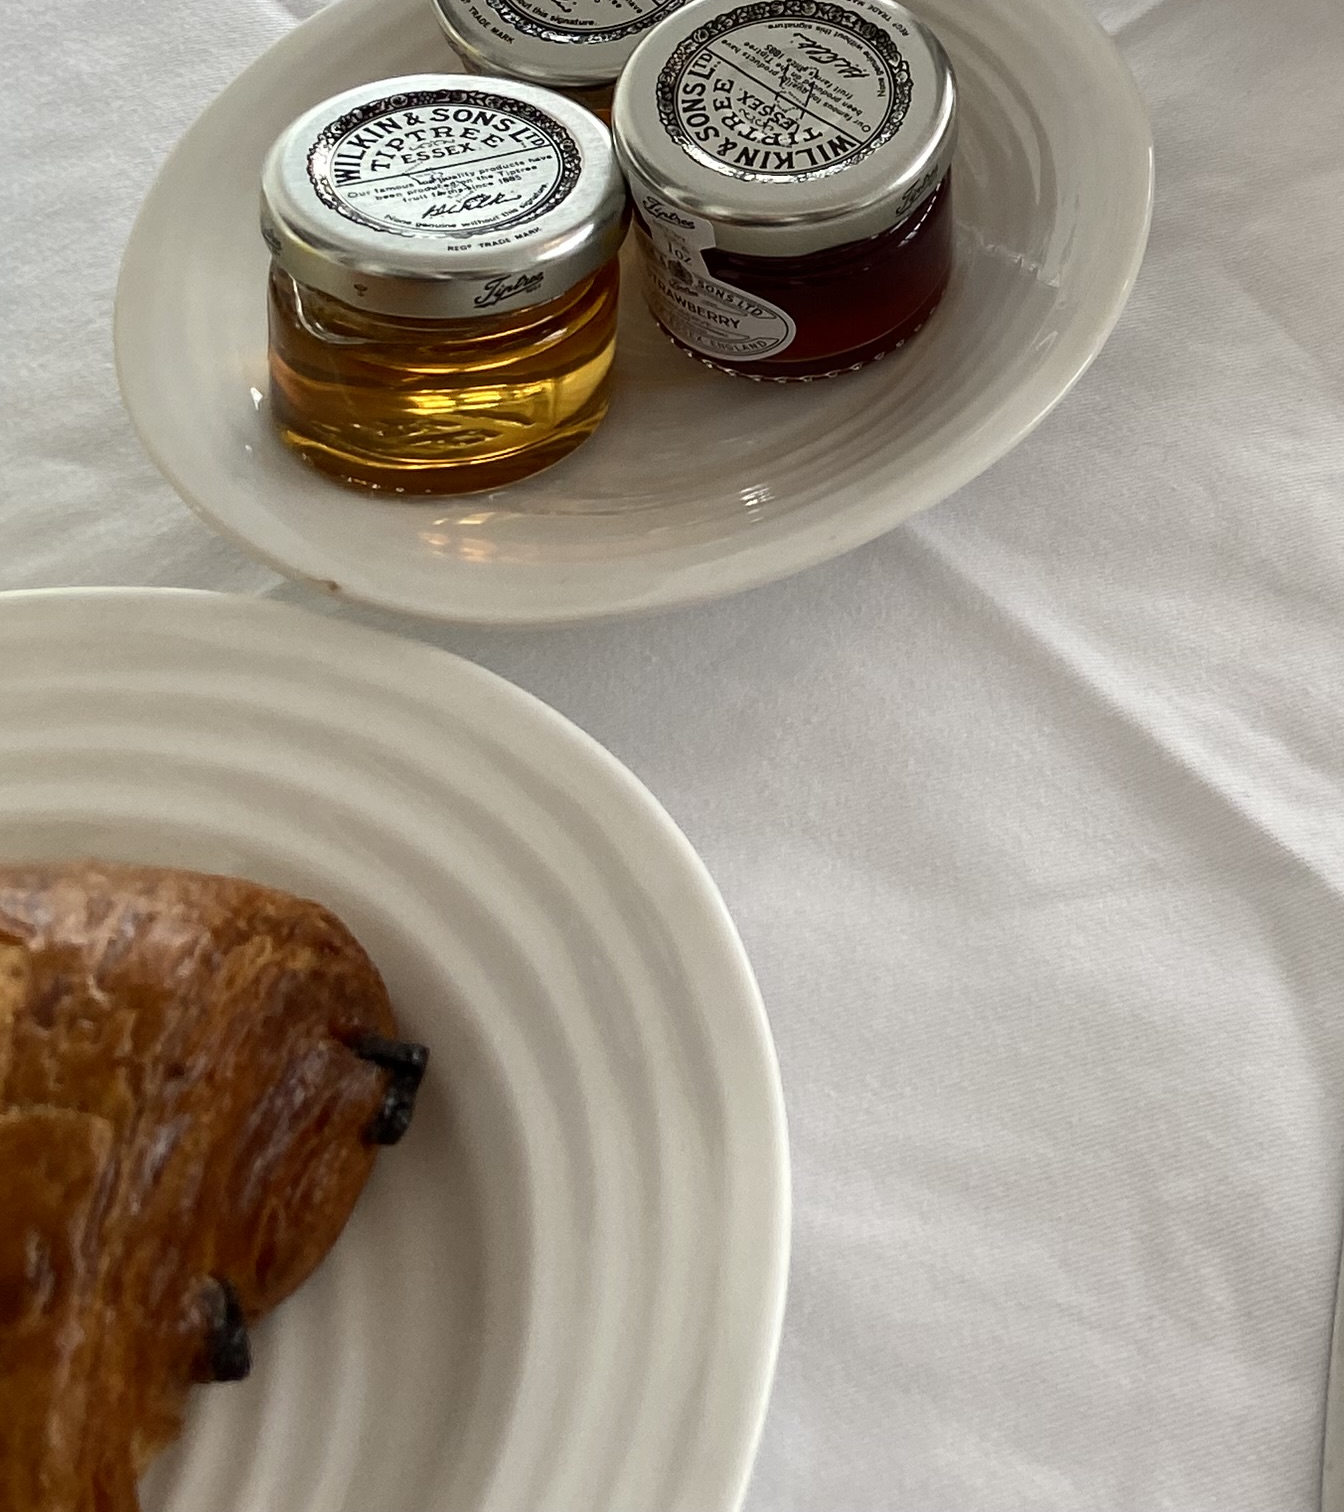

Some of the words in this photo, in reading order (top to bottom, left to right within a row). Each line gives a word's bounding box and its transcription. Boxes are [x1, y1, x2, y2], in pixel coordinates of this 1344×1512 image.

[532, 6, 549, 19] this
[867, 4, 892, 22] TRADE
[468, 5, 492, 29] TRADE
[490, 26, 515, 44] MARK
[721, 39, 741, 54] have
[743, 41, 774, 64] Tiptree
[742, 51, 780, 76] products
[832, 86, 853, 100] fruit
[681, 82, 720, 142] SONS
[713, 78, 823, 146] TIPTREE
[823, 102, 853, 121] famous
[842, 101, 863, 116] been
[853, 120, 871, 133] Our
[334, 117, 403, 184] WILKIN
[403, 111, 426, 127] &
[430, 107, 517, 133] SONS
[371, 126, 504, 172] TIPTREE
[716, 137, 738, 156] &
[733, 135, 857, 170] WILKIN
[347, 190, 371, 199] Our
[374, 183, 414, 193] famous
[479, 161, 525, 175] products
[528, 155, 552, 163] have
[498, 165, 537, 177] Tiptree
[402, 194, 428, 202] fruit
[384, 214, 412, 225] None
[460, 215, 500, 227] without
[501, 208, 519, 218] this
[642, 195, 696, 230] Tiptree
[478, 237, 511, 248] TRADE
[514, 227, 542, 240] MARK
[473, 271, 544, 309] Tiptree
[650, 271, 740, 329] TRAWBERRY
[737, 299, 763, 317] LTD
